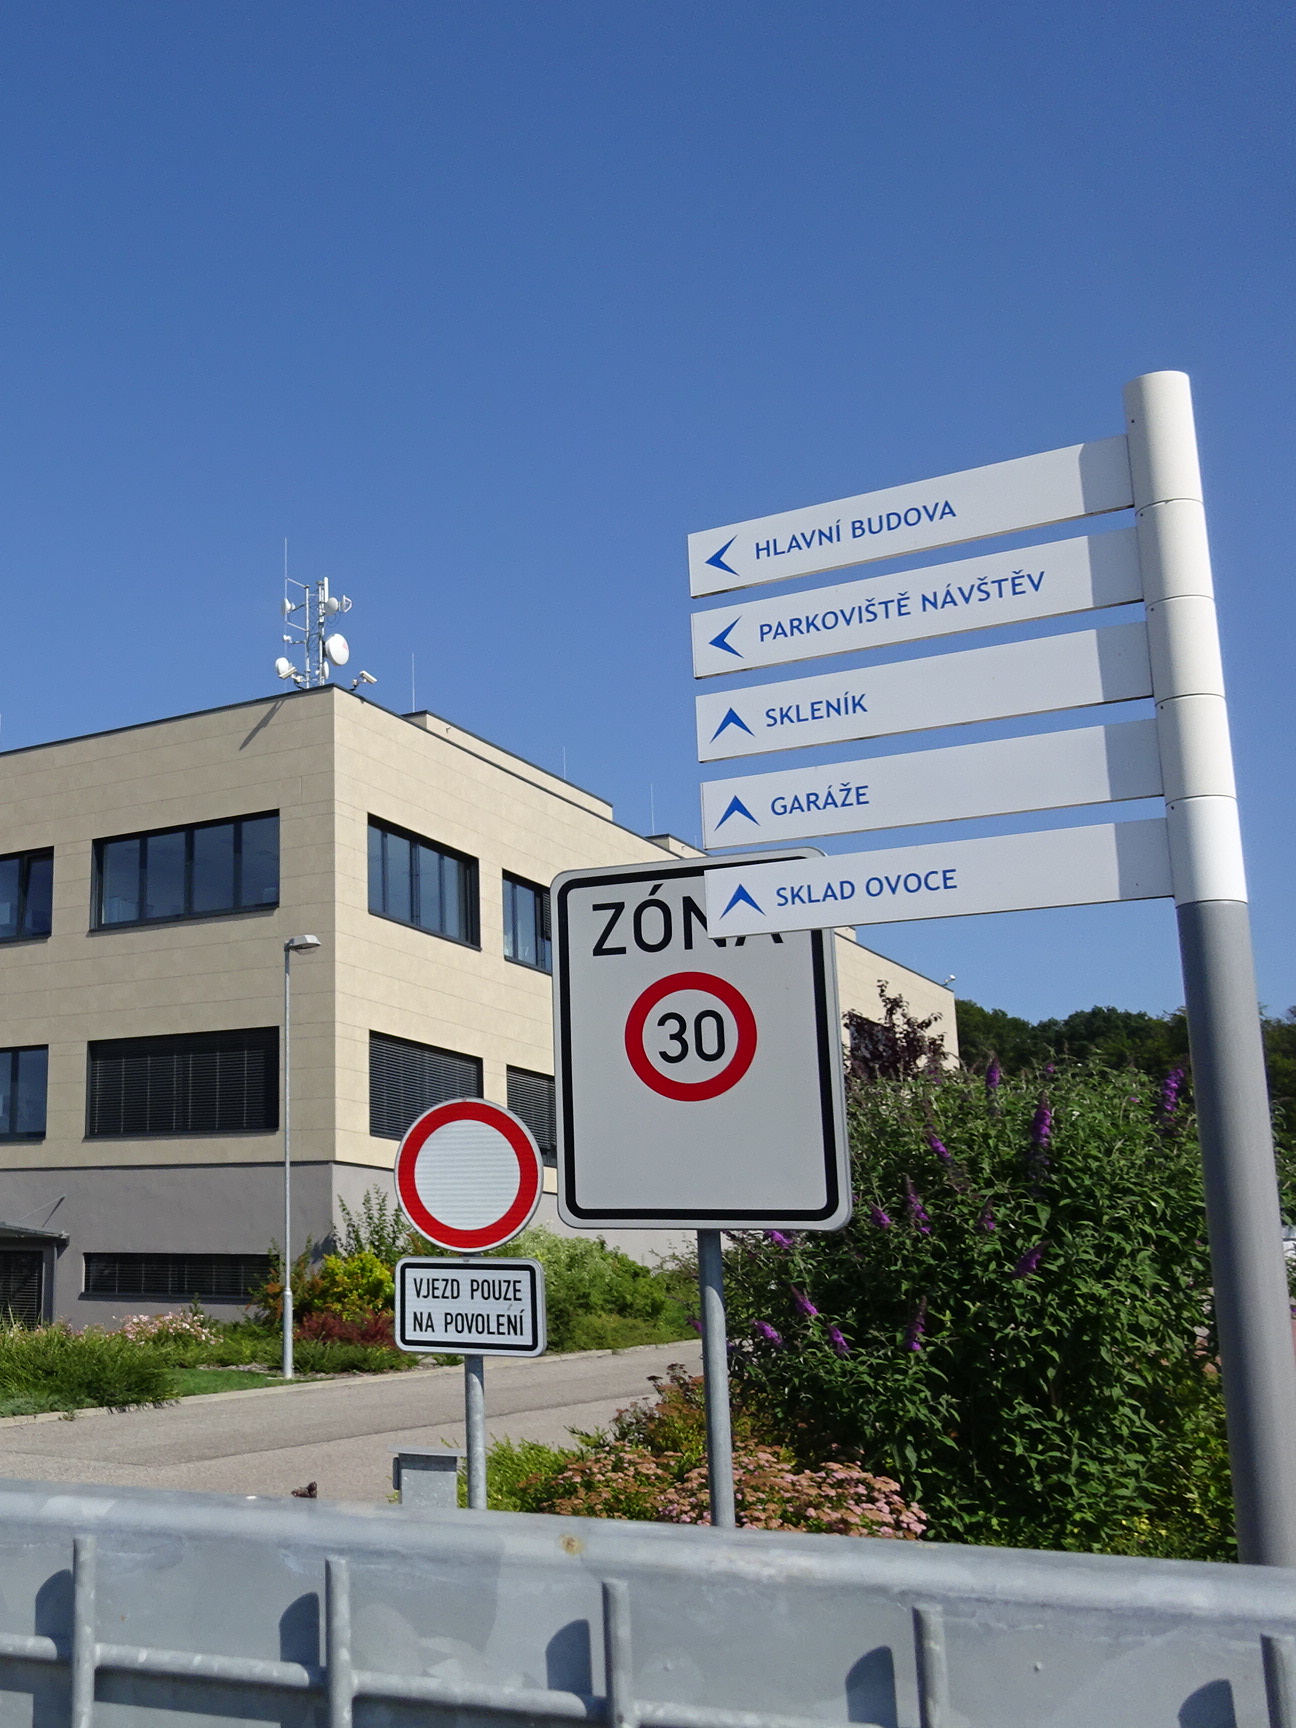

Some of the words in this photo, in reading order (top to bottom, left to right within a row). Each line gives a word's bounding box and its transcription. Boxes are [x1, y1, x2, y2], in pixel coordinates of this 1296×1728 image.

[755, 518, 842, 560] HLAVNÍ
[851, 499, 957, 538] BUDOVA
[758, 590, 911, 642] PARKOVIŠTĚ
[921, 568, 1045, 612] NÁVŠTĚV
[765, 692, 868, 728] SKLENÍK
[770, 784, 870, 816] GARÁŽE
[776, 881, 856, 907] SKLAD
[865, 869, 958, 897] OVOCE
[592, 883, 784, 957] ZÓN
[657, 1010, 725, 1063] 30
[414, 1278, 460, 1300] VJEZD
[471, 1279, 522, 1301] POUZE
[413, 1311, 435, 1332] NA
[444, 1309, 524, 1336] POVOLENÍ
